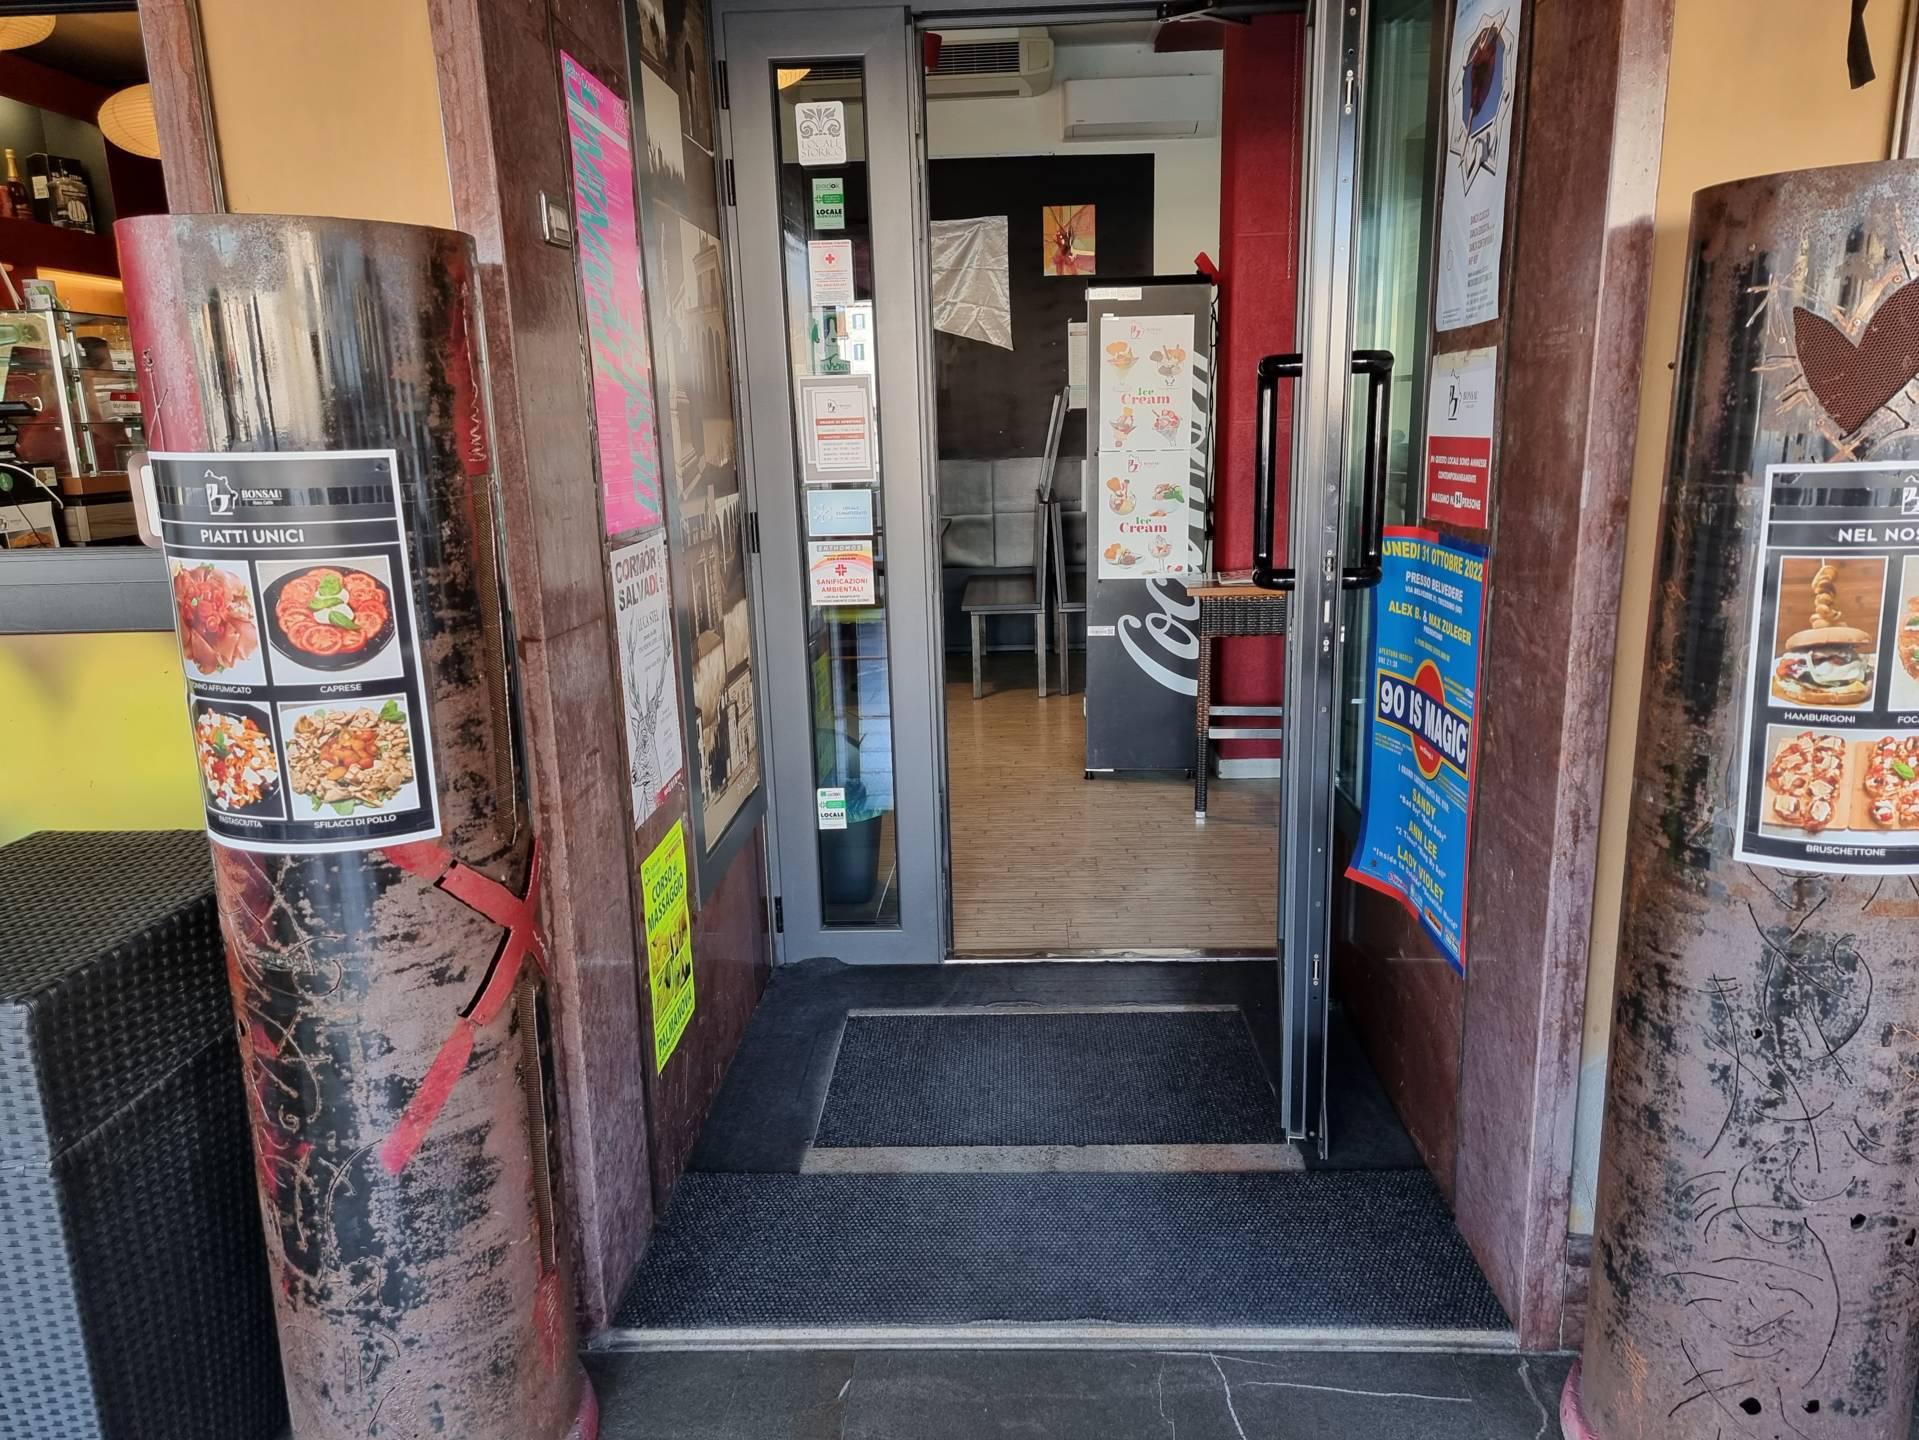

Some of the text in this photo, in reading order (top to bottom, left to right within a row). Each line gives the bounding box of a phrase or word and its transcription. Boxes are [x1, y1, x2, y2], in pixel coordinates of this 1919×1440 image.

[1121, 393, 1170, 404] Cream
[1138, 387, 1154, 396] Ice
[1120, 522, 1167, 533] Cream
[1136, 516, 1151, 524] Ice
[200, 529, 305, 544] PIATTI UNICI
[1838, 527, 1878, 543] NEL
[1382, 540, 1483, 582] UNEDI 31 OTTOBRE 2022
[816, 578, 867, 586] SANIFICAZIONI
[1405, 570, 1463, 603] PRESSO BELVEDERE
[1388, 599, 1413, 617] ALEX
[1423, 610, 1428, 623] &
[1428, 612, 1441, 630] MAX
[1441, 619, 1472, 647] ZULEGER
[208, 684, 252, 694] AFFUMICATO
[320, 683, 363, 693] CAPRESE
[1381, 680, 1405, 719] 90
[1409, 689, 1423, 730] IS
[1424, 699, 1467, 764] MAGIC
[1783, 711, 1856, 724] HAMBURGONI
[1412, 788, 1436, 820] SANDY
[313, 814, 397, 829] SFILACCI DI POLLO
[1409, 820, 1438, 860] ANN LEE
[1805, 844, 1886, 857] BRUSCHETTONE
[1397, 844, 1417, 873] LADY
[1418, 864, 1444, 903] VIOLET
[652, 866, 672, 904] CORSO
[648, 872, 684, 935] MASSAGGIO
